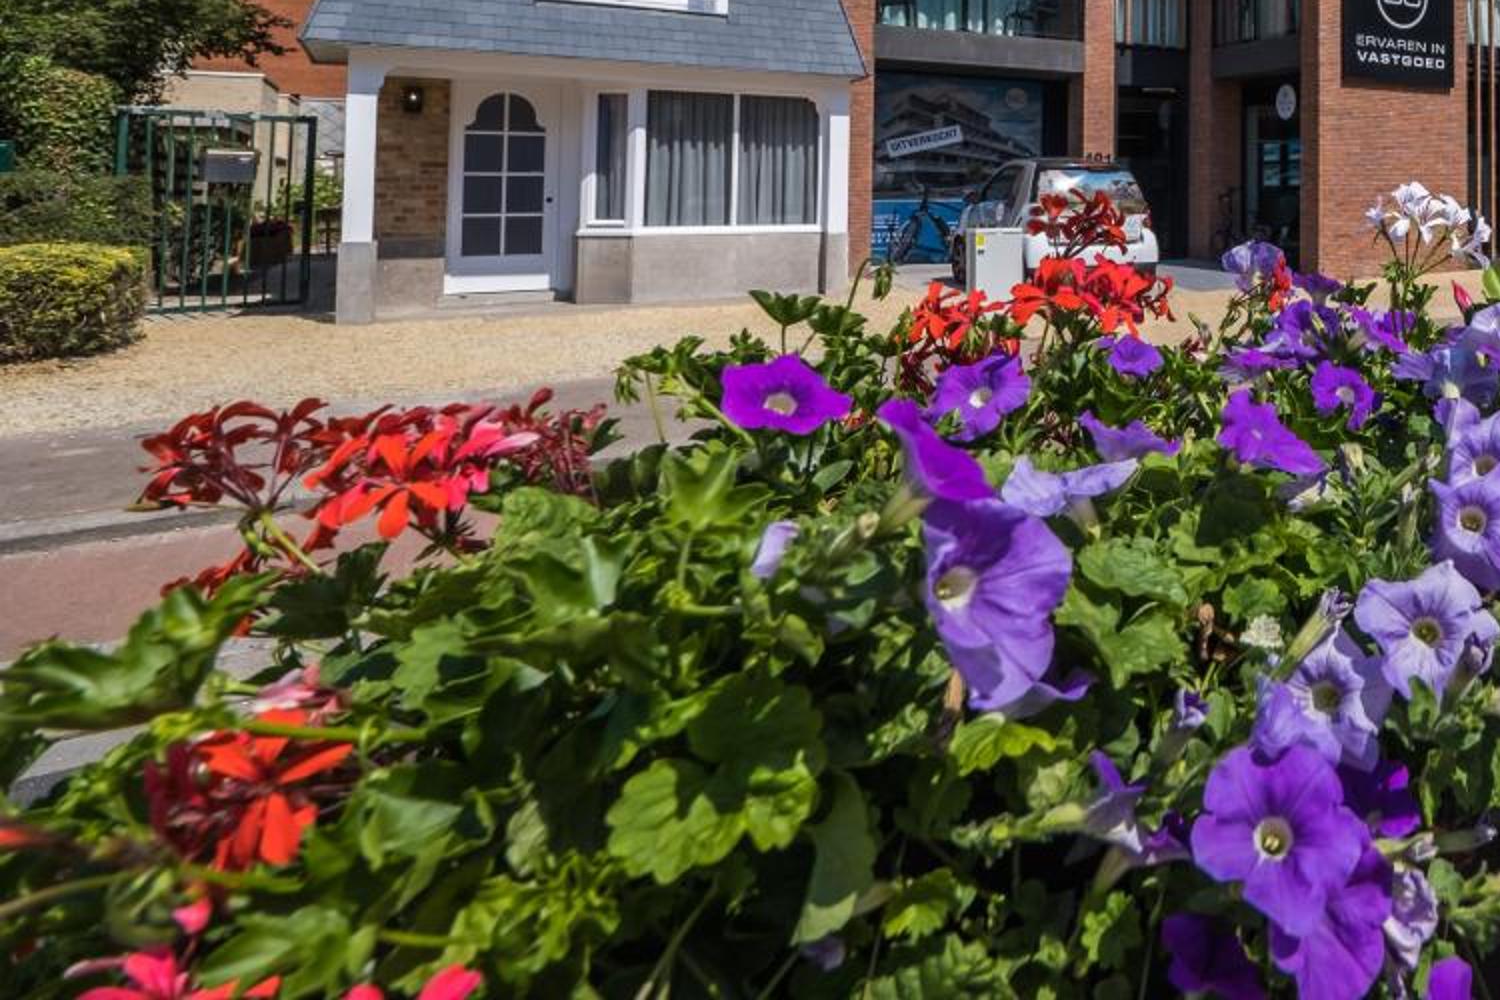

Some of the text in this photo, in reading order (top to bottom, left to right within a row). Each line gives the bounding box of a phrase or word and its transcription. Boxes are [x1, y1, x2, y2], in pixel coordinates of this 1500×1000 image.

[1355, 33, 1446, 55] ERVAREN IN
[1356, 50, 1446, 69] VASTGOED
